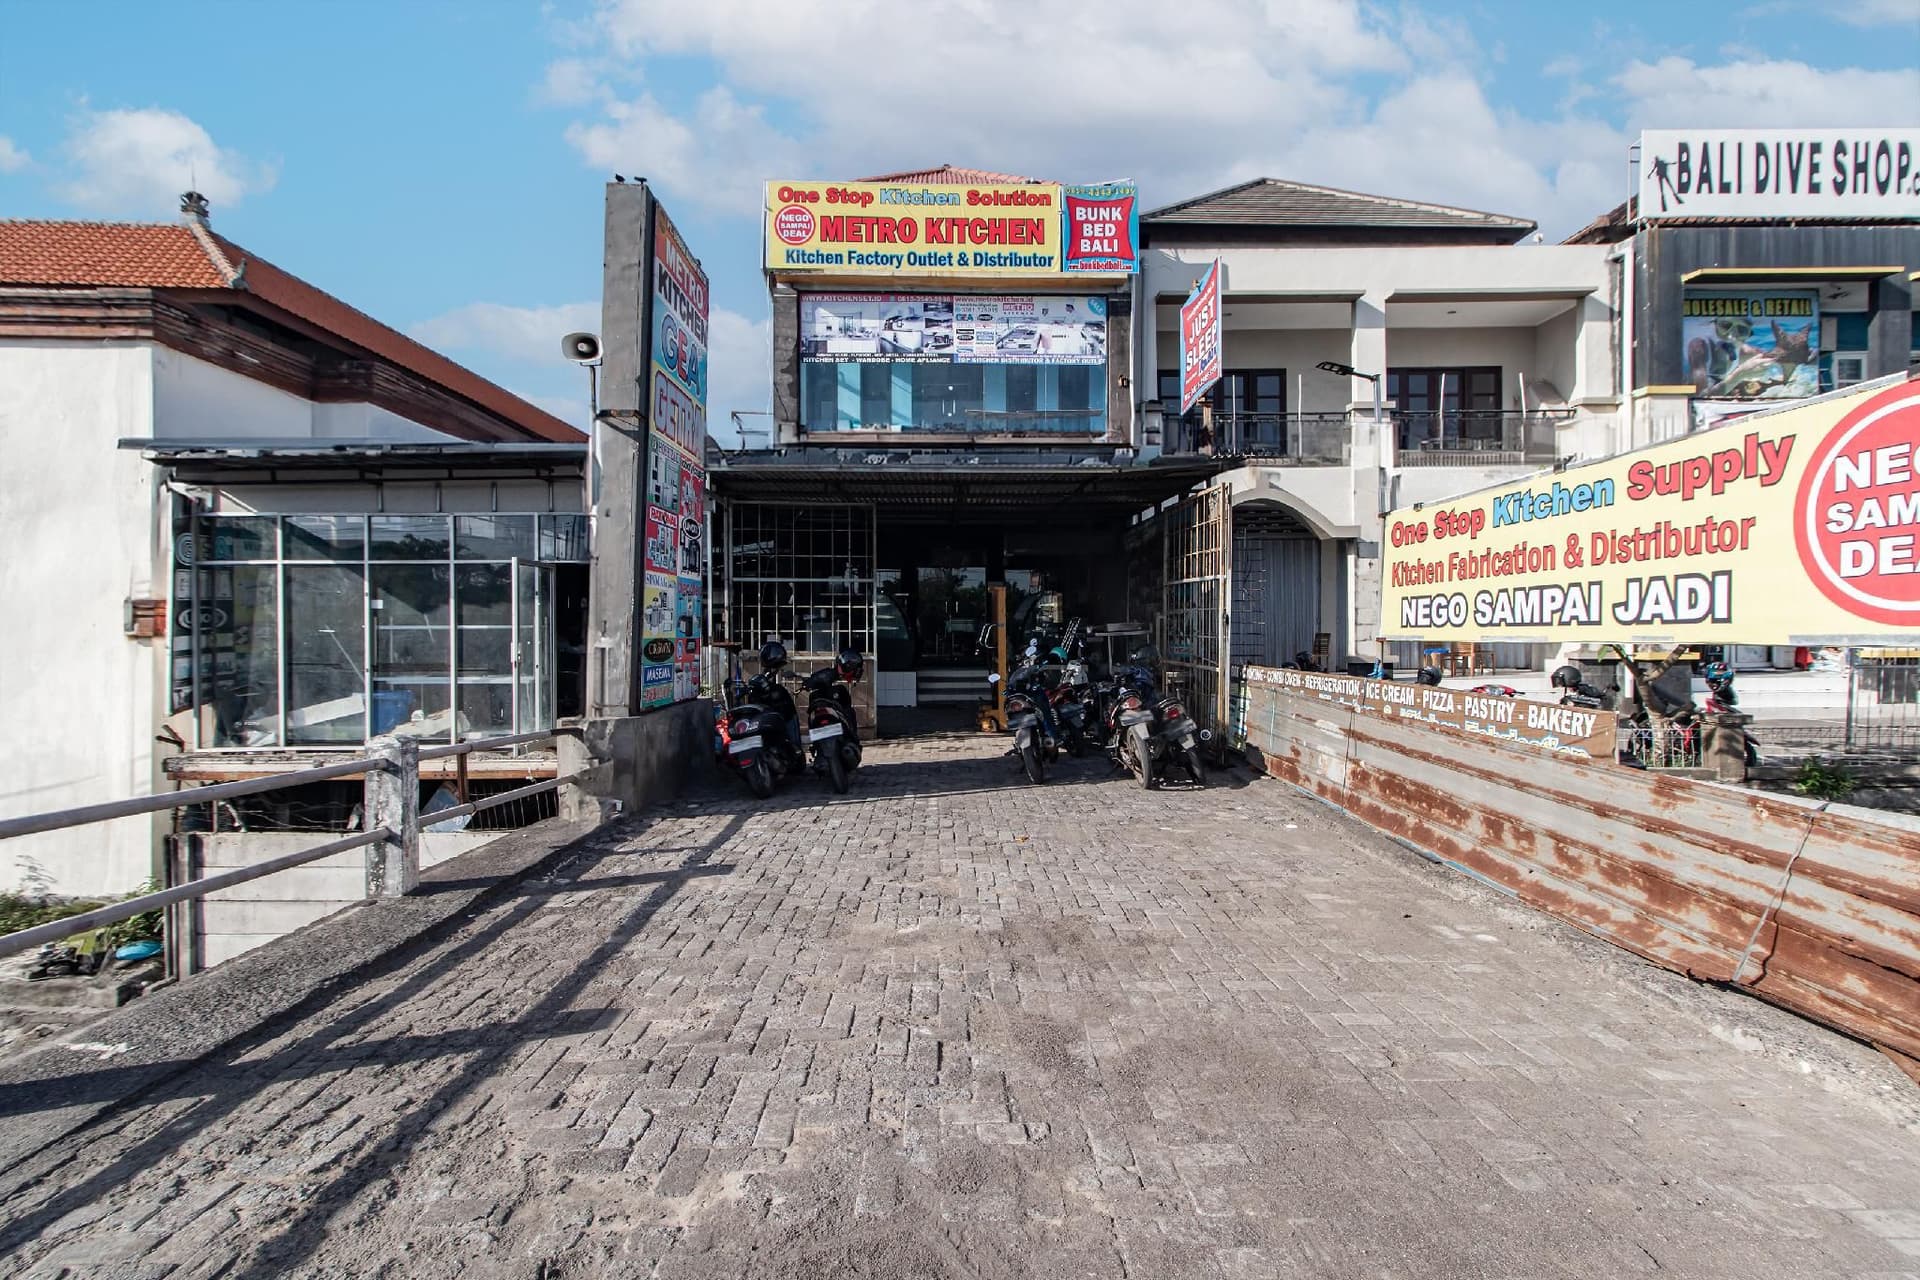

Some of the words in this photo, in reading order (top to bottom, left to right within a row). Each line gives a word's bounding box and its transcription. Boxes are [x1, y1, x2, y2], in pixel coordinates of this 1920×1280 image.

[1677, 141, 1742, 194] BALI
[1755, 141, 1822, 194] DIVE
[778, 186, 820, 203] One
[826, 187, 874, 208] Stop
[880, 188, 960, 206] Kitchen
[966, 189, 1051, 206] Solution
[781, 214, 809, 222] NEGO
[1075, 206, 1123, 221] BUNK
[820, 215, 919, 244] METRO
[925, 217, 1045, 245] KITCHEN
[1080, 238, 1118, 252] BALI
[1082, 223, 1116, 237] BED
[665, 238, 705, 310] METRO
[786, 248, 844, 265] Kitchen
[847, 250, 904, 269] Factory
[907, 251, 954, 267] Outlet
[957, 252, 969, 267] &
[973, 252, 1055, 267] Distributor
[657, 262, 708, 347] KITCHEN
[1189, 295, 1214, 344] JUST
[1750, 299, 1762, 317] &
[1765, 298, 1812, 317] RETAIL
[661, 312, 700, 396] GEA
[1186, 319, 1217, 373] SLEEP
[654, 370, 705, 459] GETRA
[1391, 521, 1428, 548] One
[1434, 508, 1486, 539] Stop
[1493, 476, 1614, 528] Kitchen
[1627, 432, 1796, 501] Supply
[1391, 557, 1444, 588] Kitchen
[1448, 541, 1557, 582] Fabrication
[1563, 532, 1585, 569] &
[1590, 515, 1757, 566] Distributor
[1840, 533, 1920, 579] DE
[1401, 592, 1469, 628] NEGO
[1474, 581, 1603, 627] SAMPAI
[1612, 569, 1733, 626] JADI
[1305, 674, 1360, 696] REFRIGERATION
[1366, 680, 1380, 699] ICE
[1382, 684, 1415, 706] CREAM
[1422, 689, 1455, 714] PIZZA
[1464, 697, 1516, 724] PASTRY
[1527, 704, 1597, 738] BAKERY
